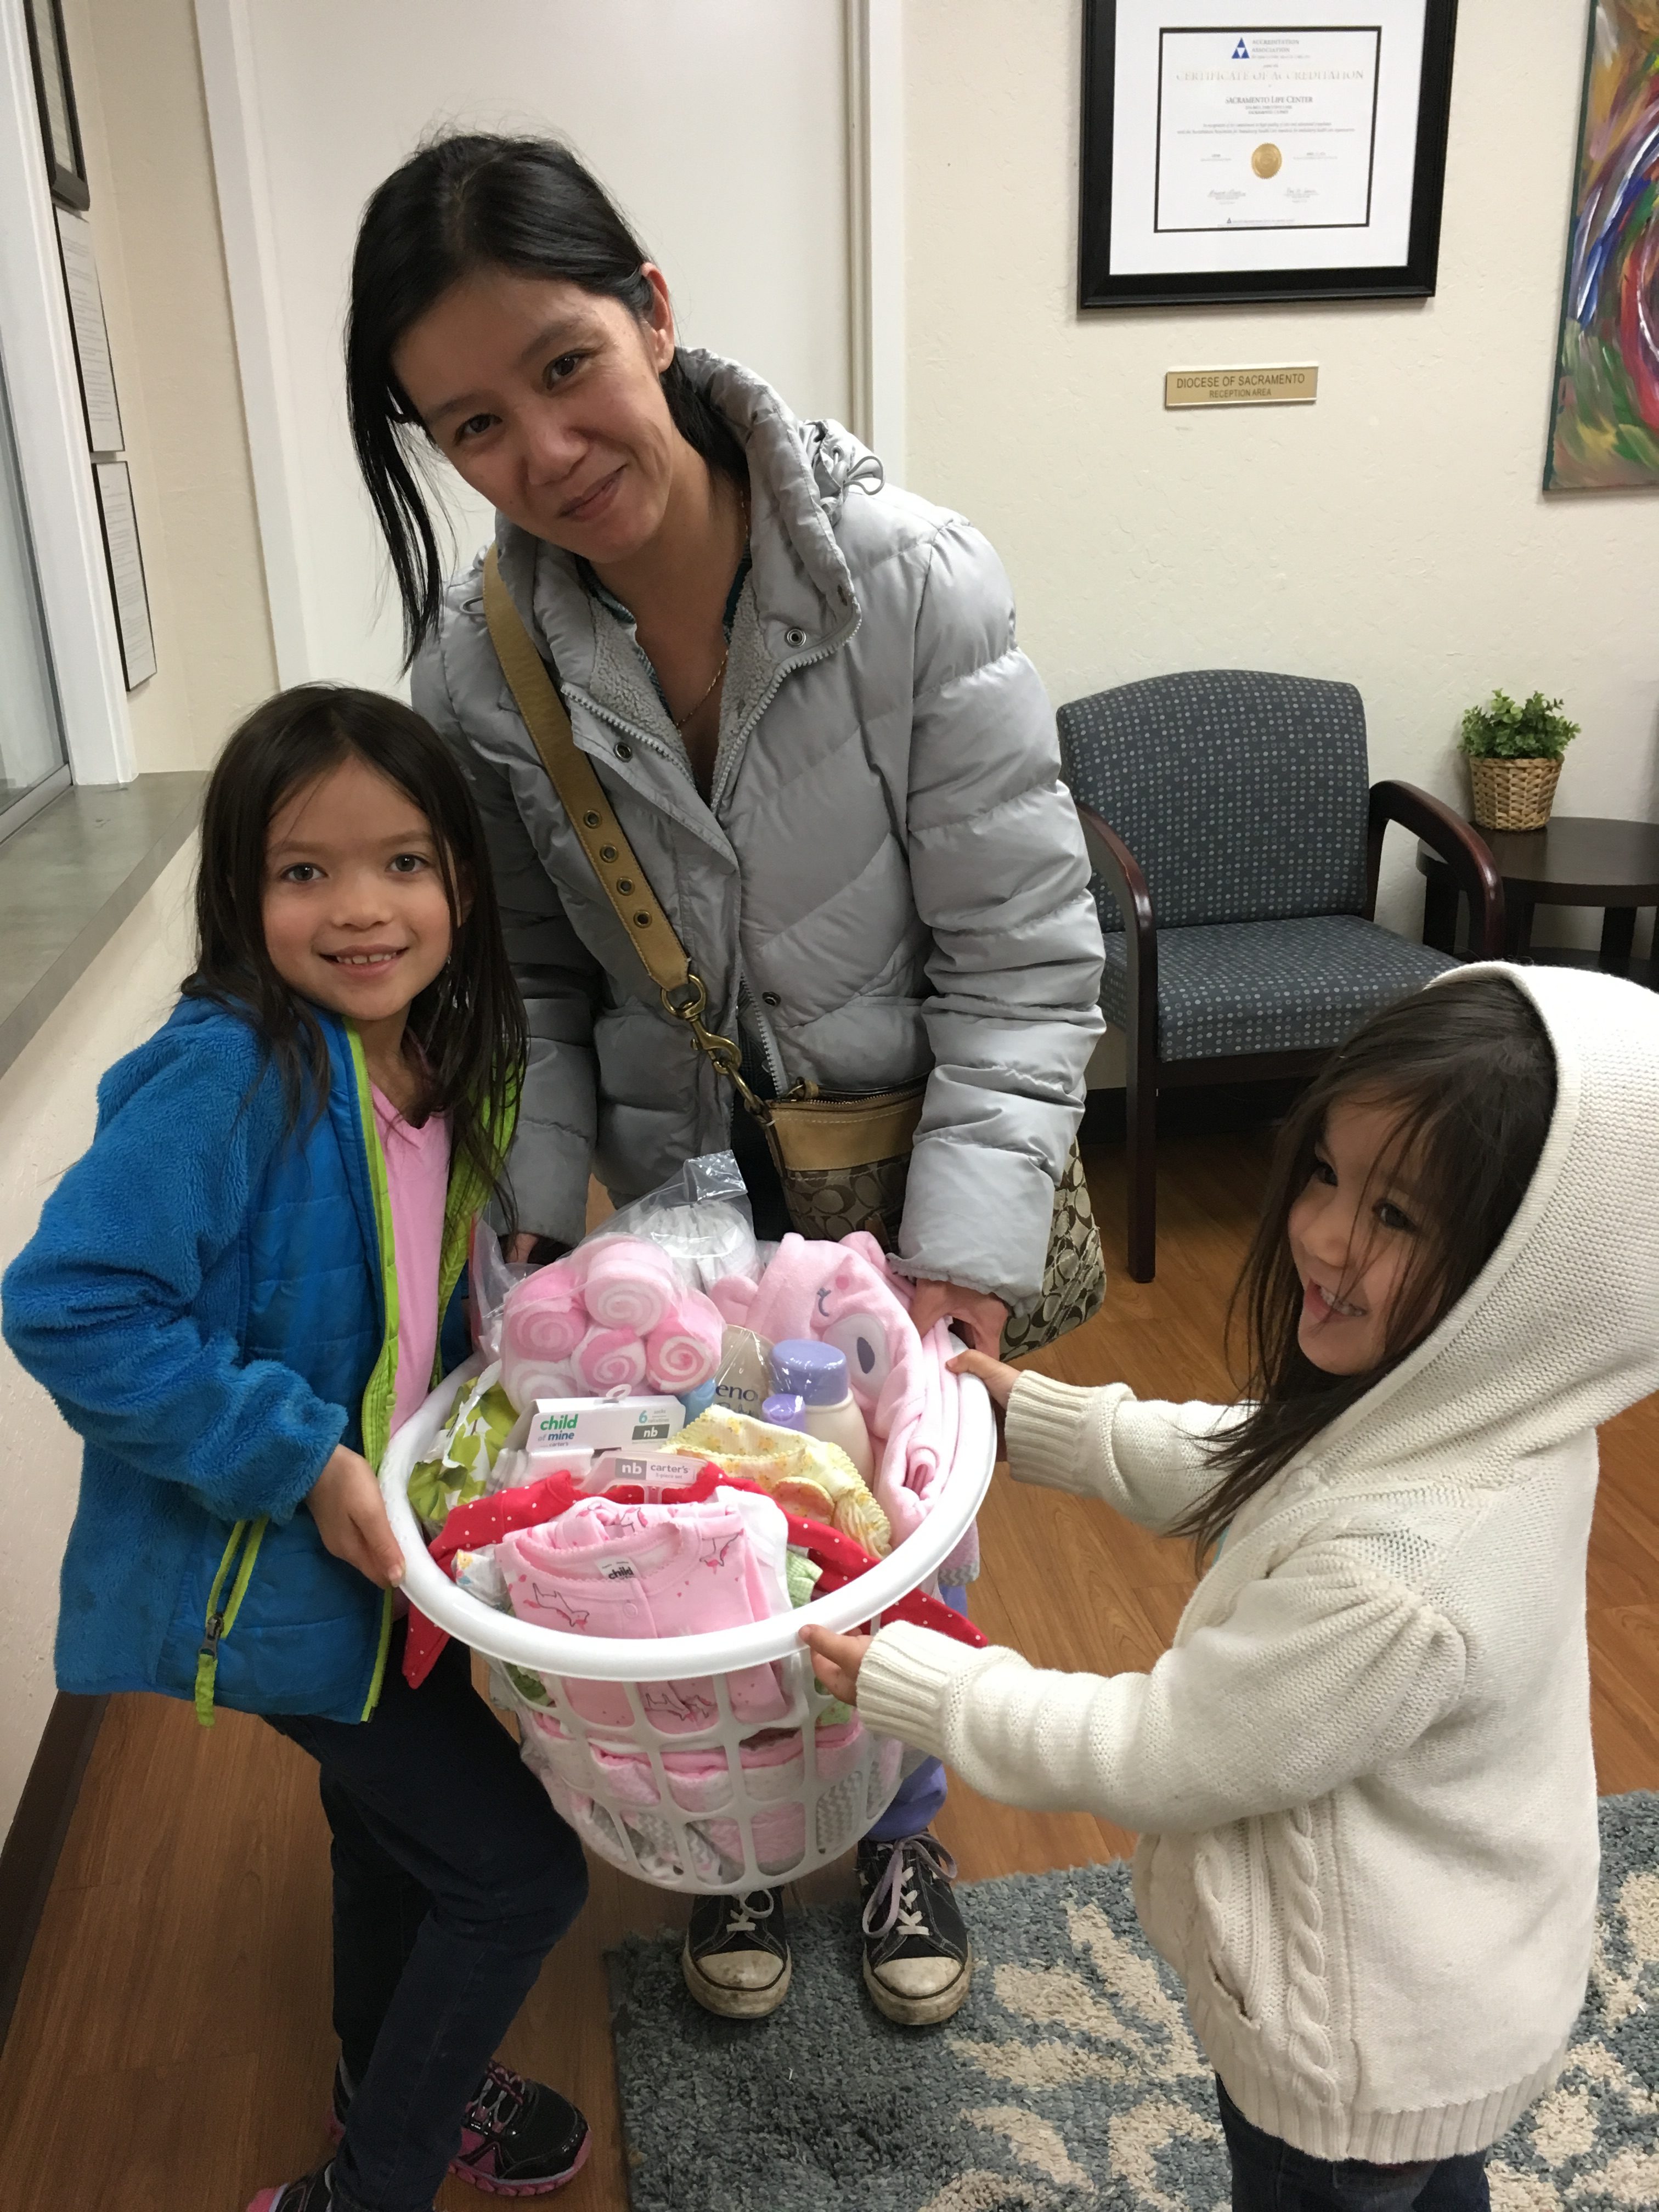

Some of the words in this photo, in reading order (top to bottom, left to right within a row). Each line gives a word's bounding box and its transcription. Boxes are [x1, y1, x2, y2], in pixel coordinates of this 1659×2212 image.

[1176, 71, 1249, 81] CERTIFICATE
[1253, 71, 1267, 81] OF
[1271, 70, 1364, 80] ACCREDITATION
[1177, 377, 1219, 388] DIOCESE
[1222, 376, 1235, 386] OF
[1238, 374, 1305, 386] SACRAMENTO
[1209, 389, 1250, 398] RECEPTION
[715, 1384, 758, 1402] eno
[540, 1414, 578, 1430] child
[639, 1410, 648, 1424] 6
[538, 1433, 547, 1441] of
[548, 1430, 574, 1441] mine
[643, 1427, 658, 1437] nb
[622, 1462, 642, 1474] nb
[650, 1464, 689, 1474] carter's
[608, 1566, 634, 1579] child
